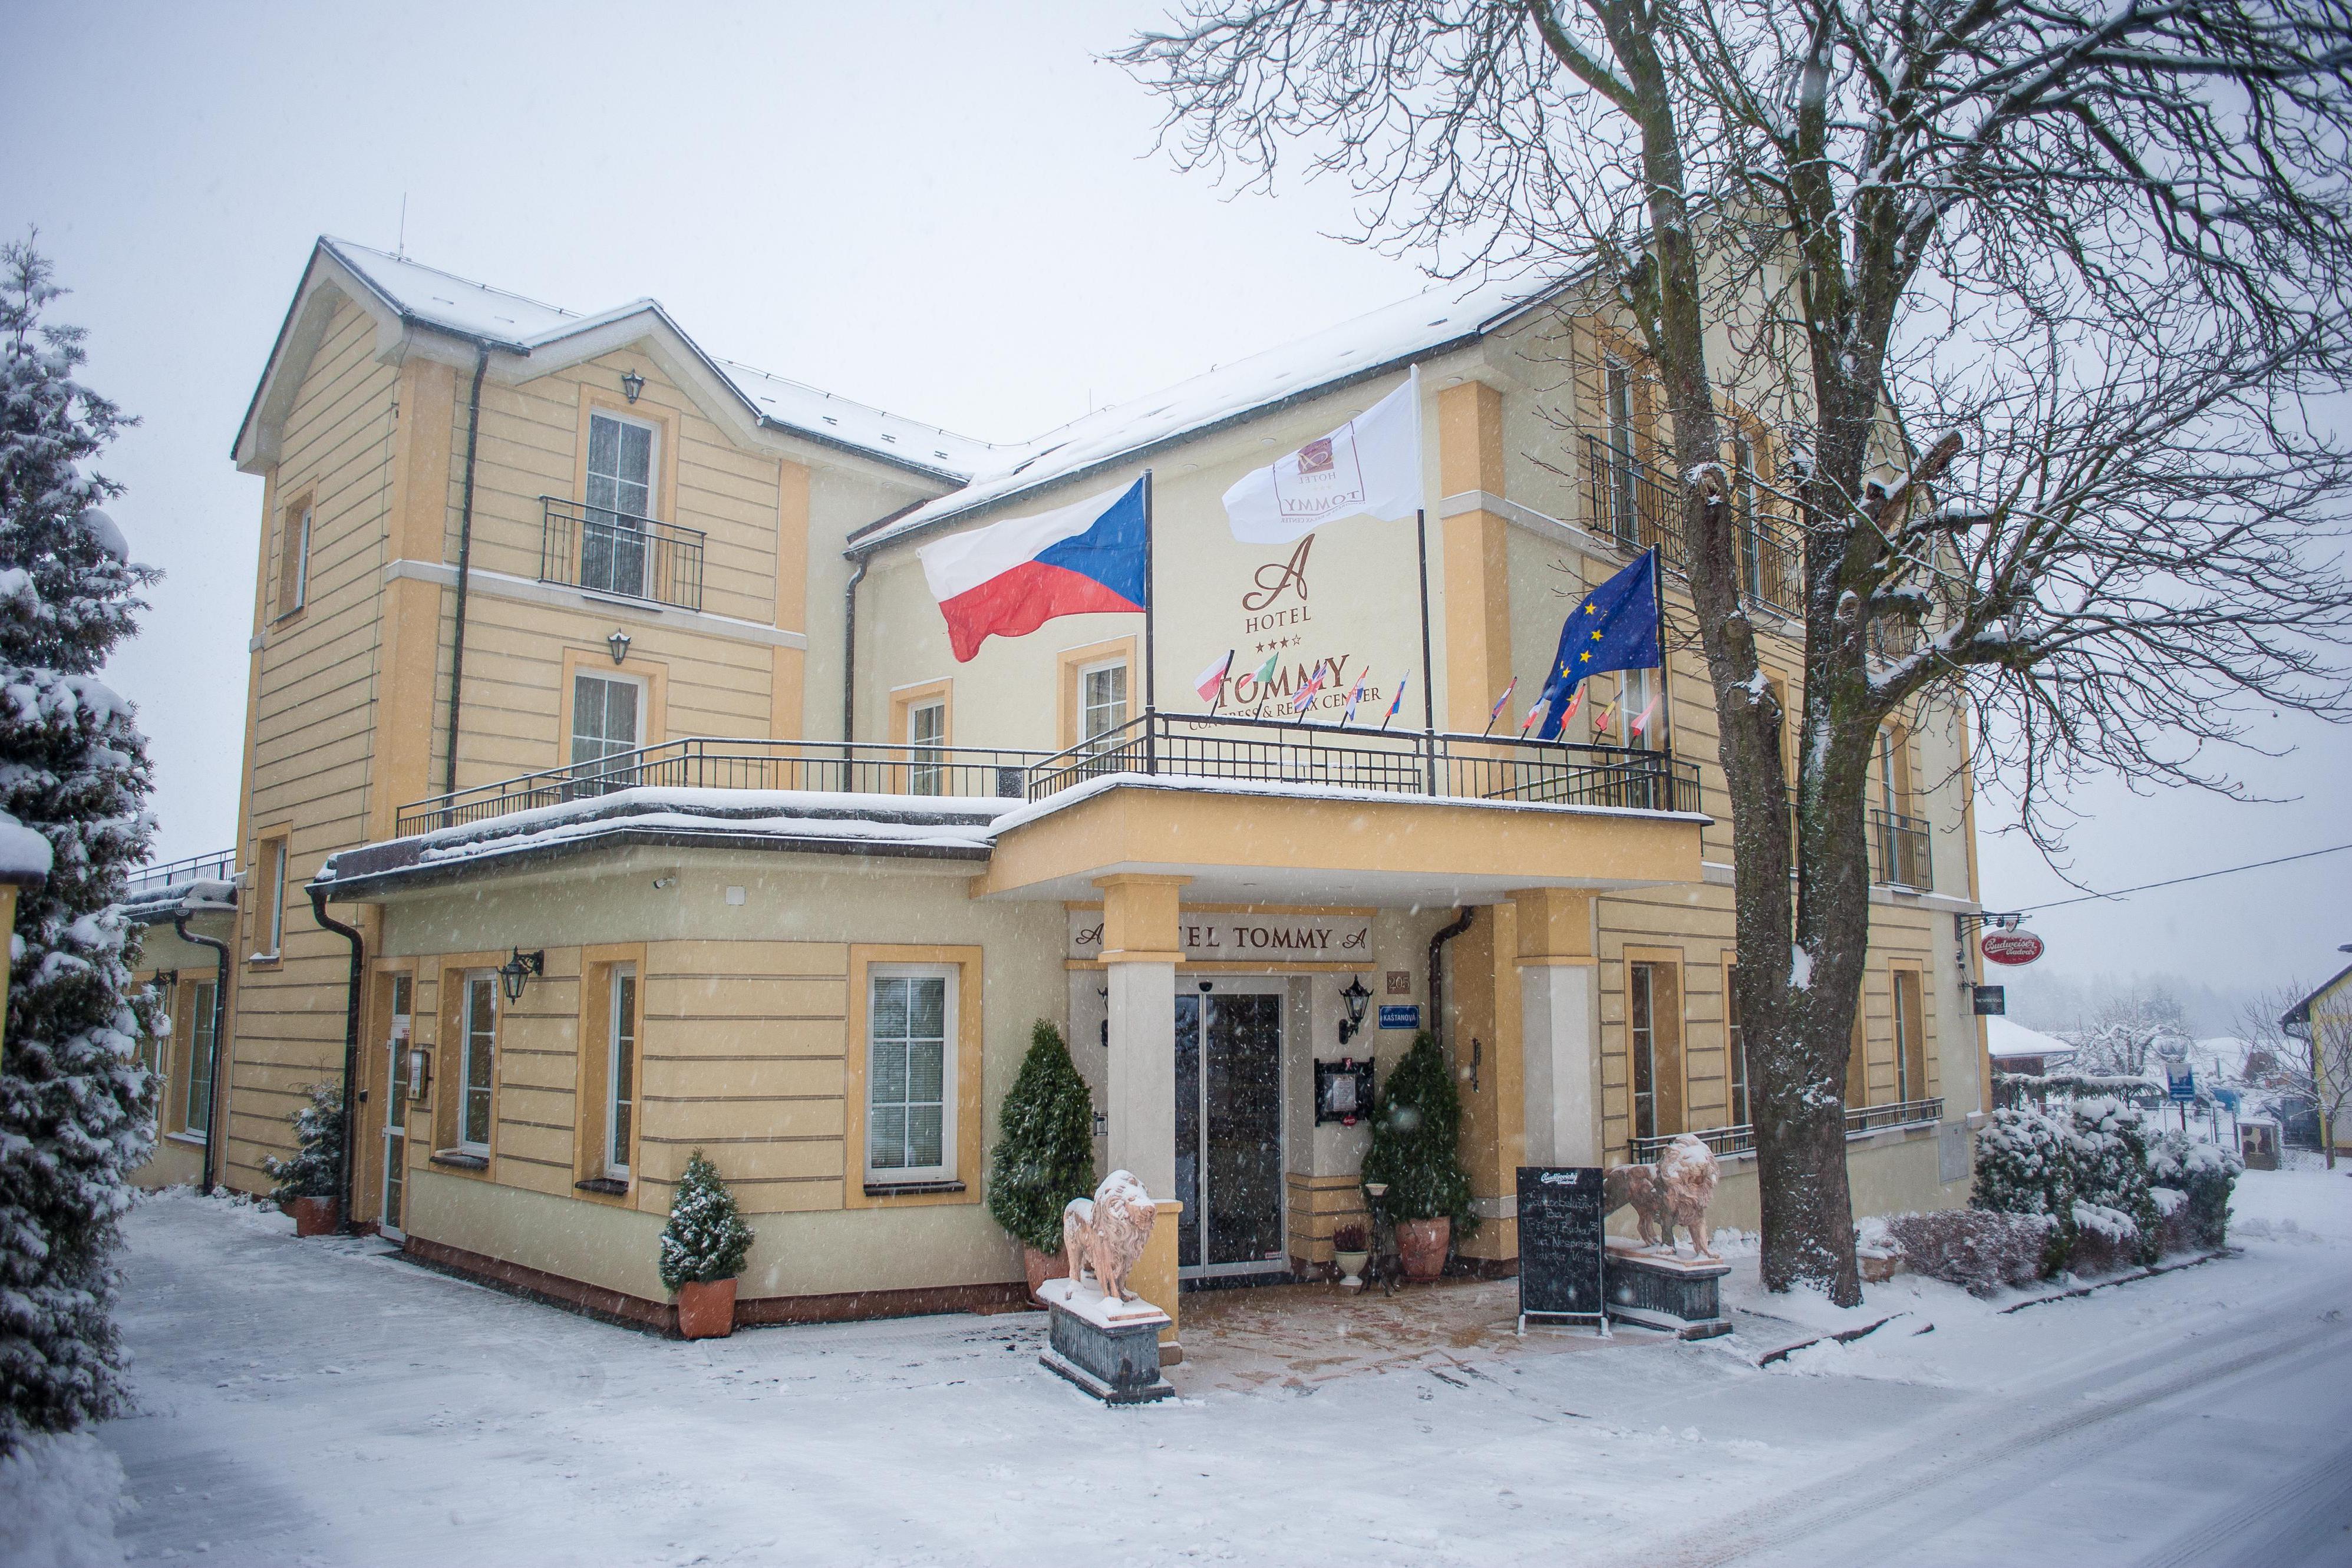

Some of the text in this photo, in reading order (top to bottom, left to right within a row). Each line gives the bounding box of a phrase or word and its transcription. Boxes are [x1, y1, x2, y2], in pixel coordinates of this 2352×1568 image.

[1245, 606, 1311, 633] HOTEL
[1263, 705, 1272, 718] &
[1323, 687, 1382, 708] CENER
[1233, 926, 1332, 949] TOMMY
[1984, 938, 2036, 952] Budweiser
[1388, 976, 1410, 989] 205
[1383, 1013, 1416, 1022] KAŠTANOVÁ
